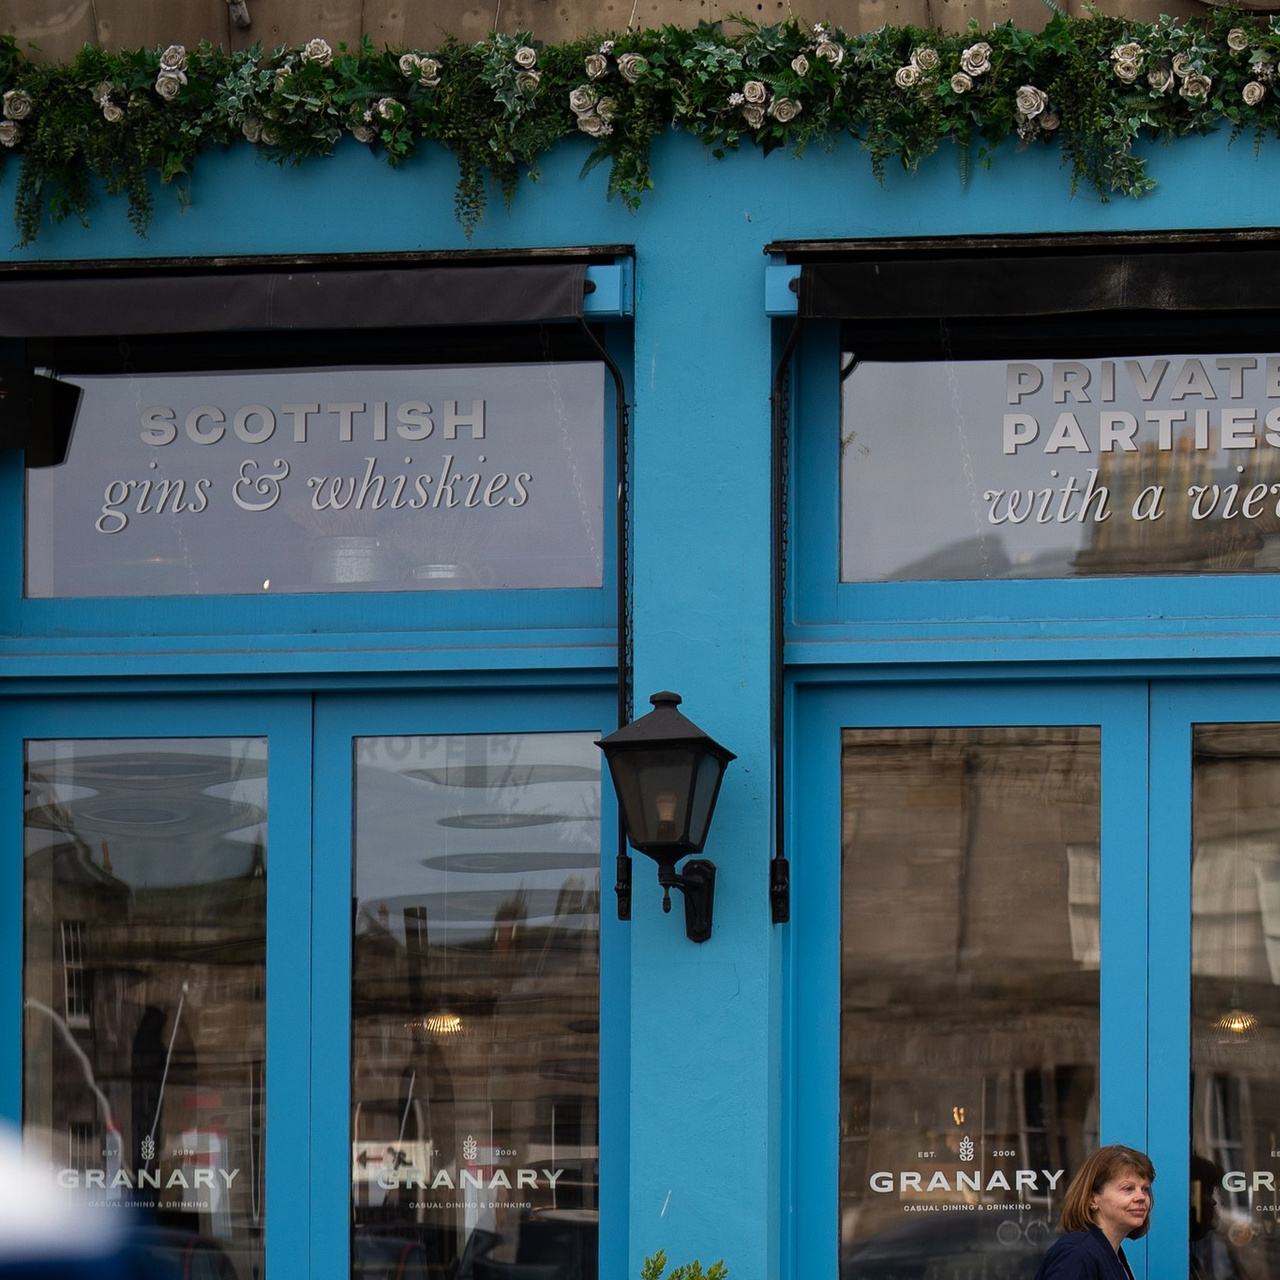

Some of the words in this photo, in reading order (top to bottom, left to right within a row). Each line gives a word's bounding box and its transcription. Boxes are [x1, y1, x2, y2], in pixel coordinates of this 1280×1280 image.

[140, 399, 486, 446] SCOTTISH
[94, 461, 212, 534] gins
[232, 458, 290, 512] &
[306, 455, 534, 511] whiskies
[983, 468, 1112, 525] with
[1131, 485, 1166, 522] a
[917, 1150, 937, 1158] EST.
[56, 1168, 241, 1189] GRANARY
[377, 1168, 565, 1190] GRANARY
[869, 1169, 1065, 1193] GRANARY
[942, 1204, 975, 1212] DINING
[986, 1203, 1032, 1211] DRINKING
